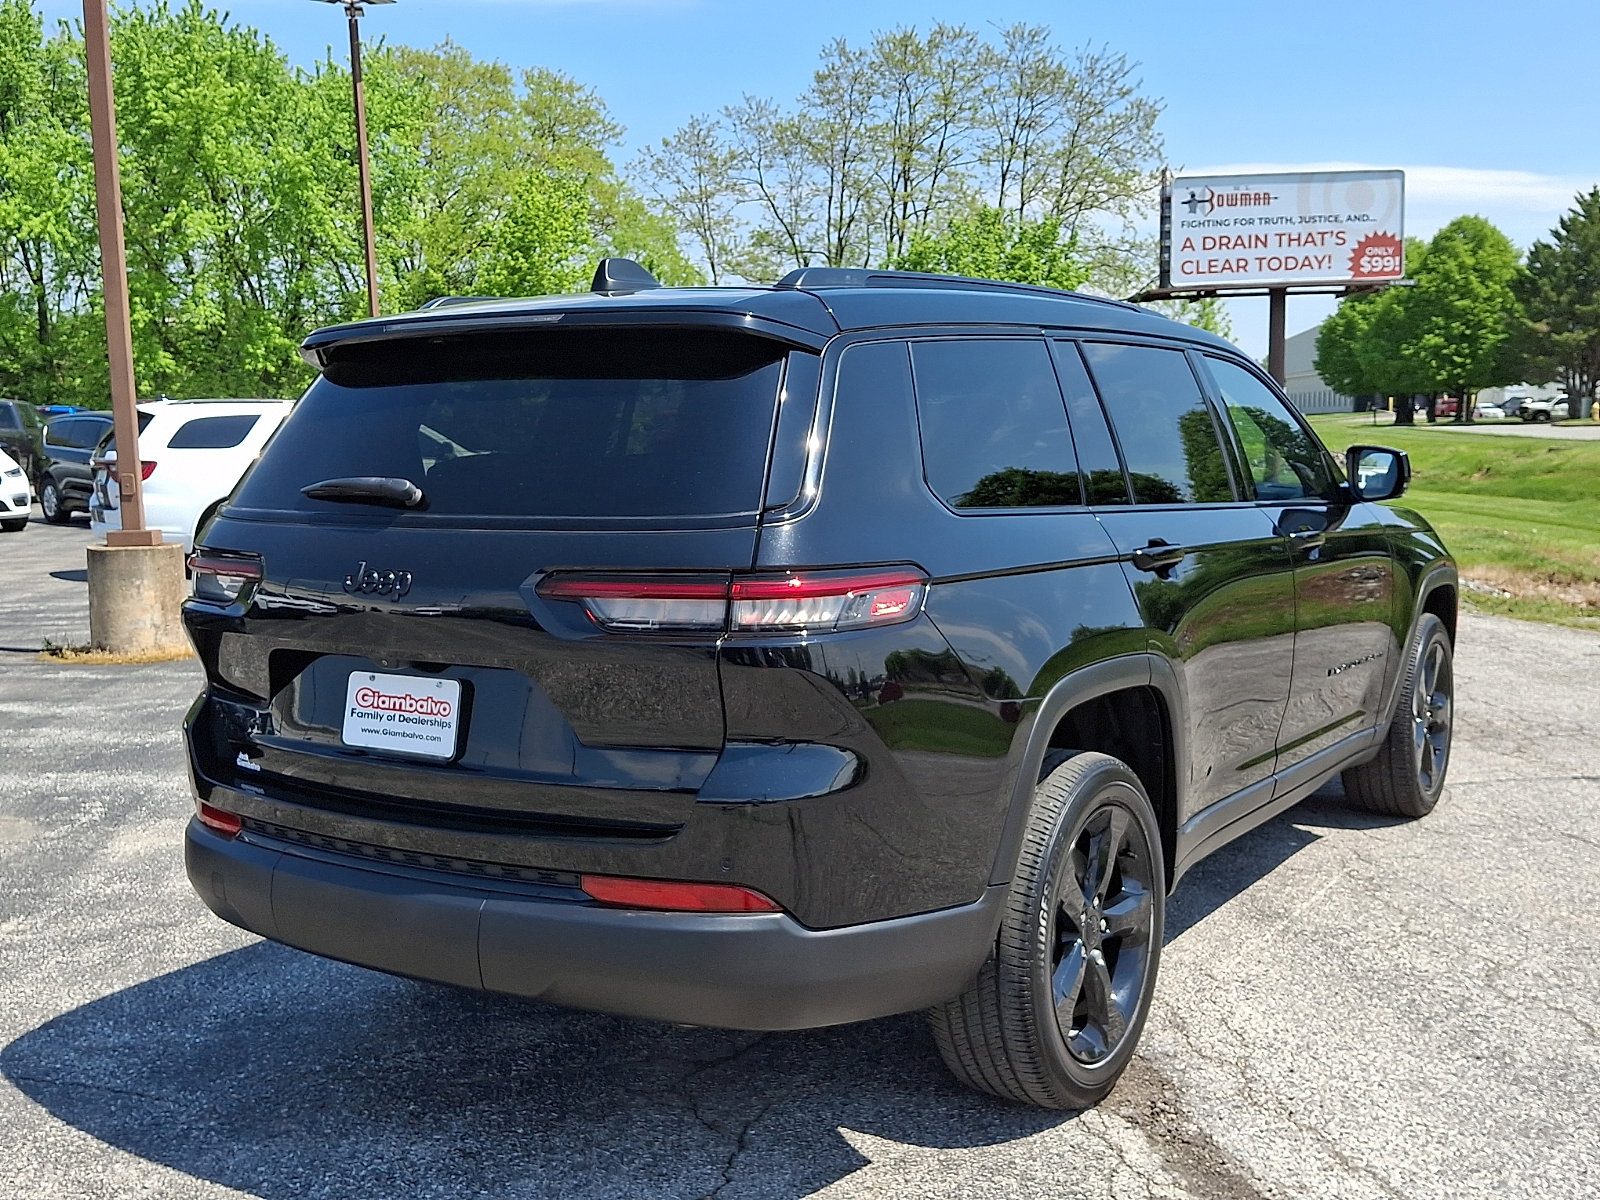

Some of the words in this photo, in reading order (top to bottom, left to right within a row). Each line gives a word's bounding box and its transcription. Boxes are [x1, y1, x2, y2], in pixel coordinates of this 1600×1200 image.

[1181, 218, 1230, 229] FIGHTING
[1233, 217, 1255, 227] FOR
[1257, 216, 1295, 226] TRUTH,
[1298, 214, 1344, 225] JUSTICE,
[1345, 213, 1377, 223] AND...
[1180, 237, 1196, 251] A
[1202, 233, 1268, 251] DRAIN
[1274, 230, 1347, 248] THAT'S
[1365, 246, 1395, 256] ONLY
[1181, 257, 1249, 275] CLEAR
[1255, 254, 1333, 272] TODAY!
[1360, 255, 1400, 274] $99!
[343, 560, 413, 602] Jeep
[355, 687, 451, 717] Giambalvo
[350, 708, 384, 722] Family
[386, 713, 396, 722] of
[398, 714, 452, 729] Dealerships
[361, 727, 442, 742] www.Giambalvo.com
